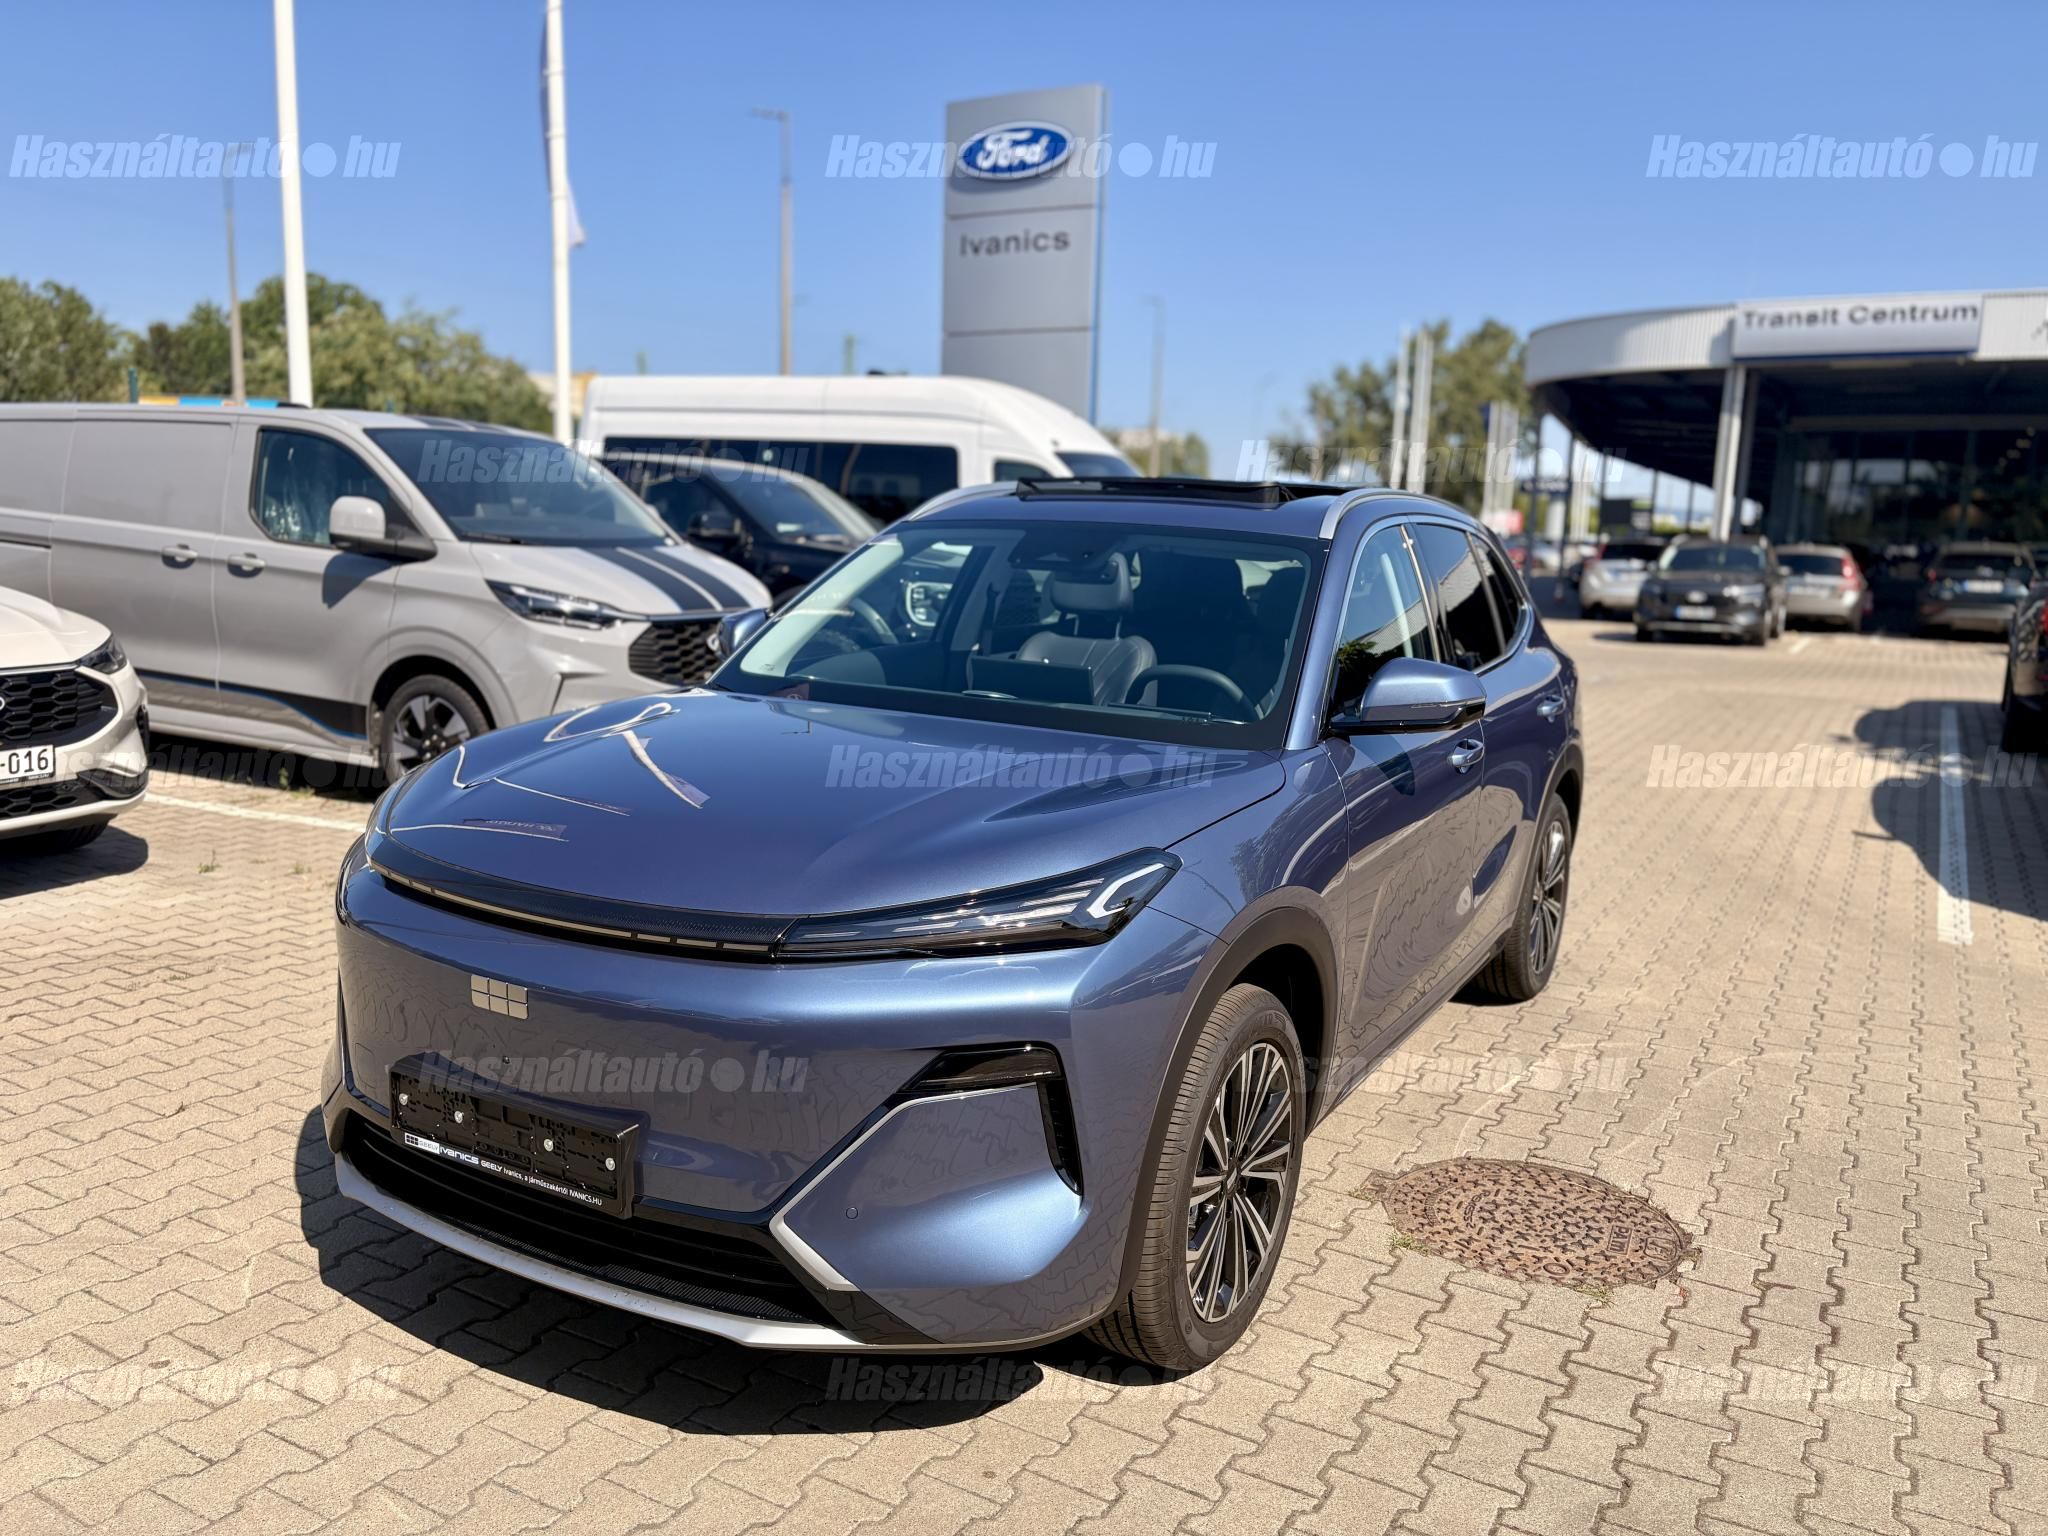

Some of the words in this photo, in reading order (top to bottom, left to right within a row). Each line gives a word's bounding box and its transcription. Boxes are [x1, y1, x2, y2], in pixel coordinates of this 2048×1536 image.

[976, 129, 1050, 169] Ford
[959, 228, 1070, 257] Ivanics
[1743, 306, 1840, 329] Transit
[1848, 302, 1979, 325] Centrum
[480, 1159, 503, 1172] GEELY
[569, 1189, 603, 1206] IVANICS.HU
[1610, 1225, 1630, 1253] PAM
